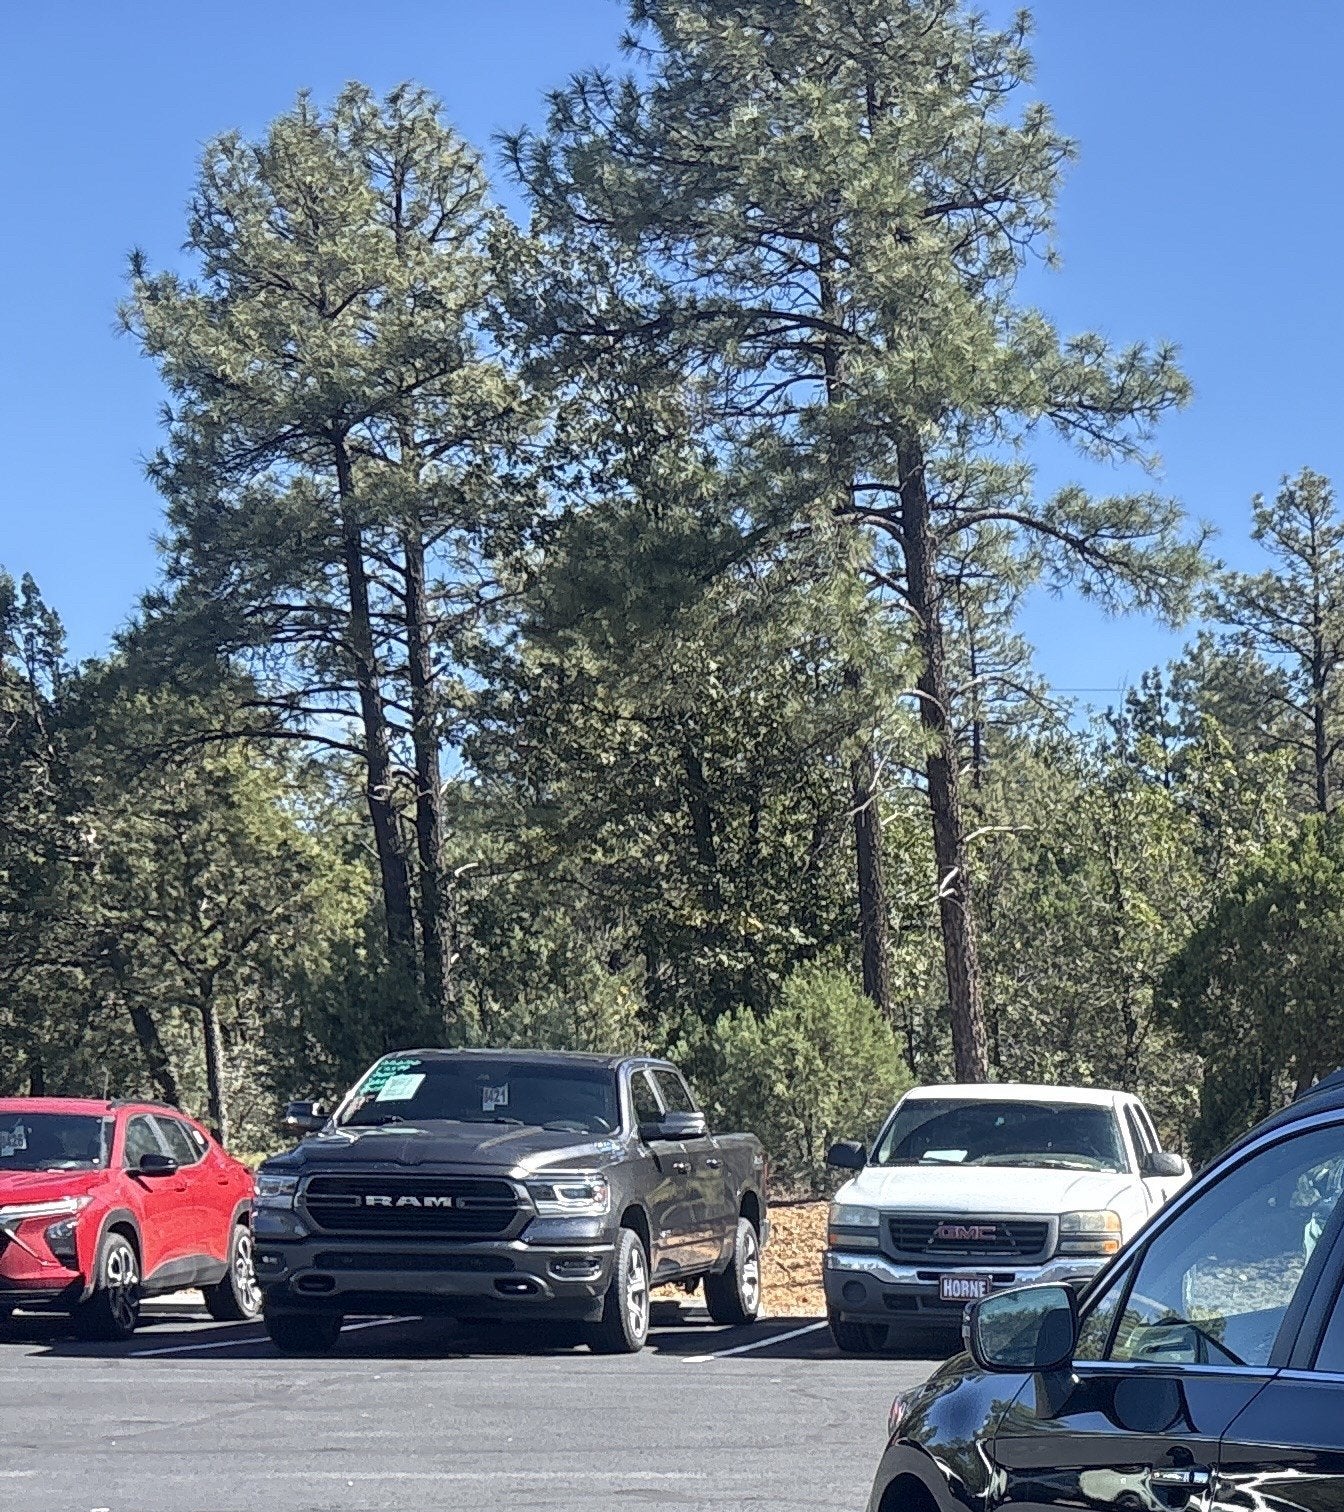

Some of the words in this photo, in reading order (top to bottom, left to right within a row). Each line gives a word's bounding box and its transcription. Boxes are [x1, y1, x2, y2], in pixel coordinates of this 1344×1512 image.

[365, 1195, 453, 1208] RAM
[938, 1225, 997, 1240] GMC
[943, 1278, 987, 1299] HORNE
